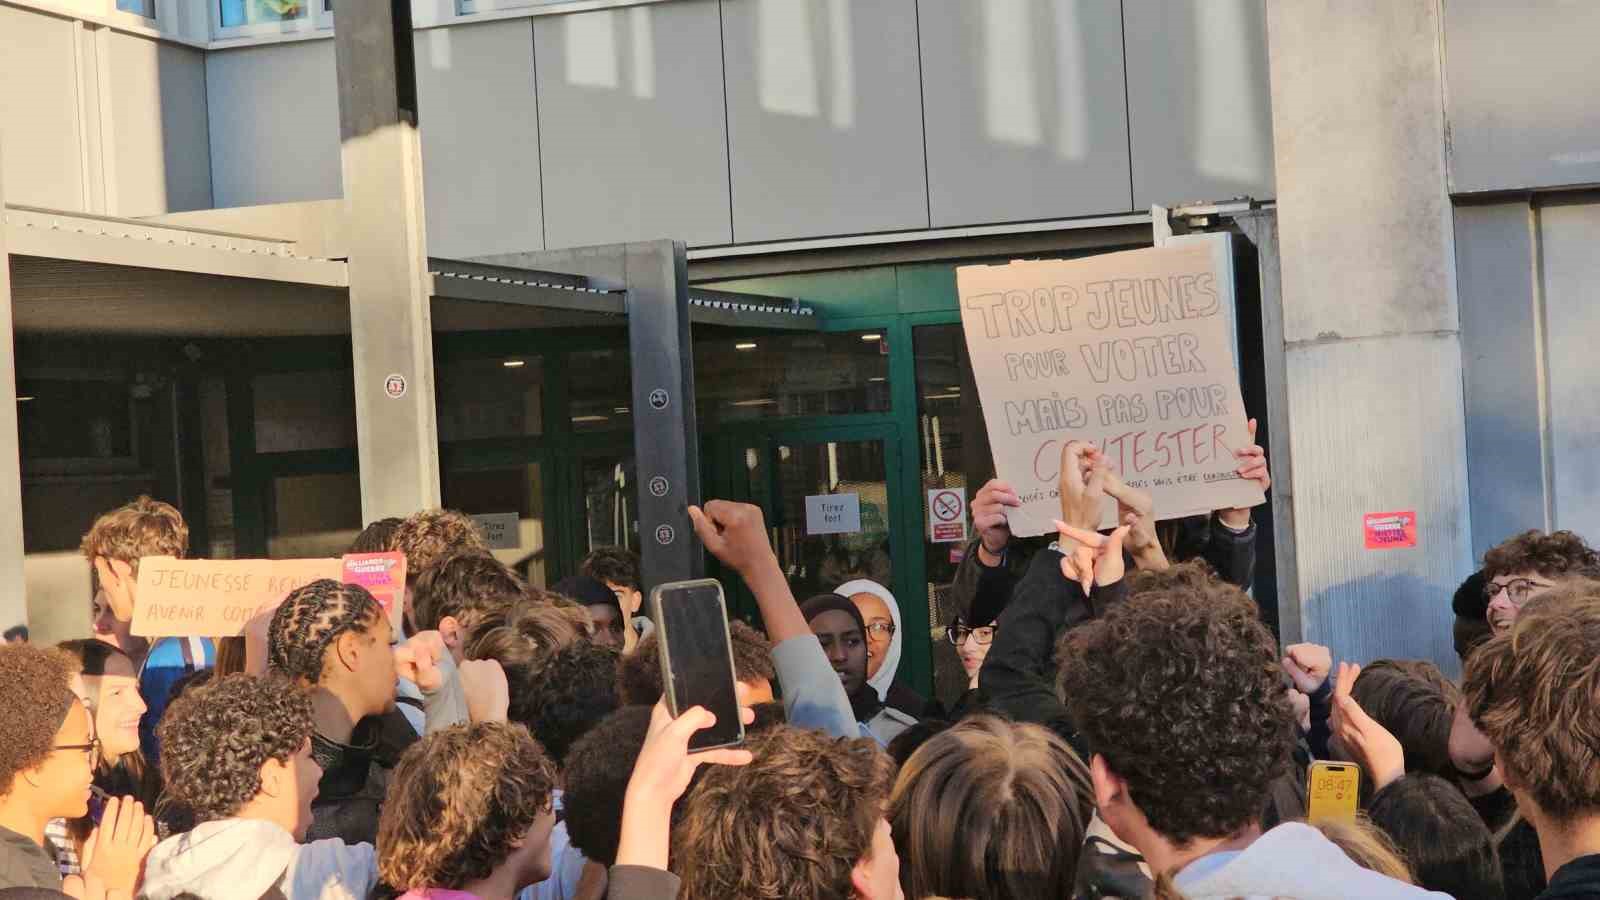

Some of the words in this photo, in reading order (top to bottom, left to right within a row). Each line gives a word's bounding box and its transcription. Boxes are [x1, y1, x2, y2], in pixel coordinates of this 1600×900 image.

[967, 285, 1079, 339] TROP
[1086, 272, 1221, 330] JEUNES
[1004, 349, 1071, 382] POUR
[1079, 332, 1207, 384] VOTER
[1096, 393, 1149, 427] PAS
[1155, 383, 1230, 421] POUR
[1033, 423, 1234, 484] CTESTER
[151, 569, 253, 593] JEUNESSE
